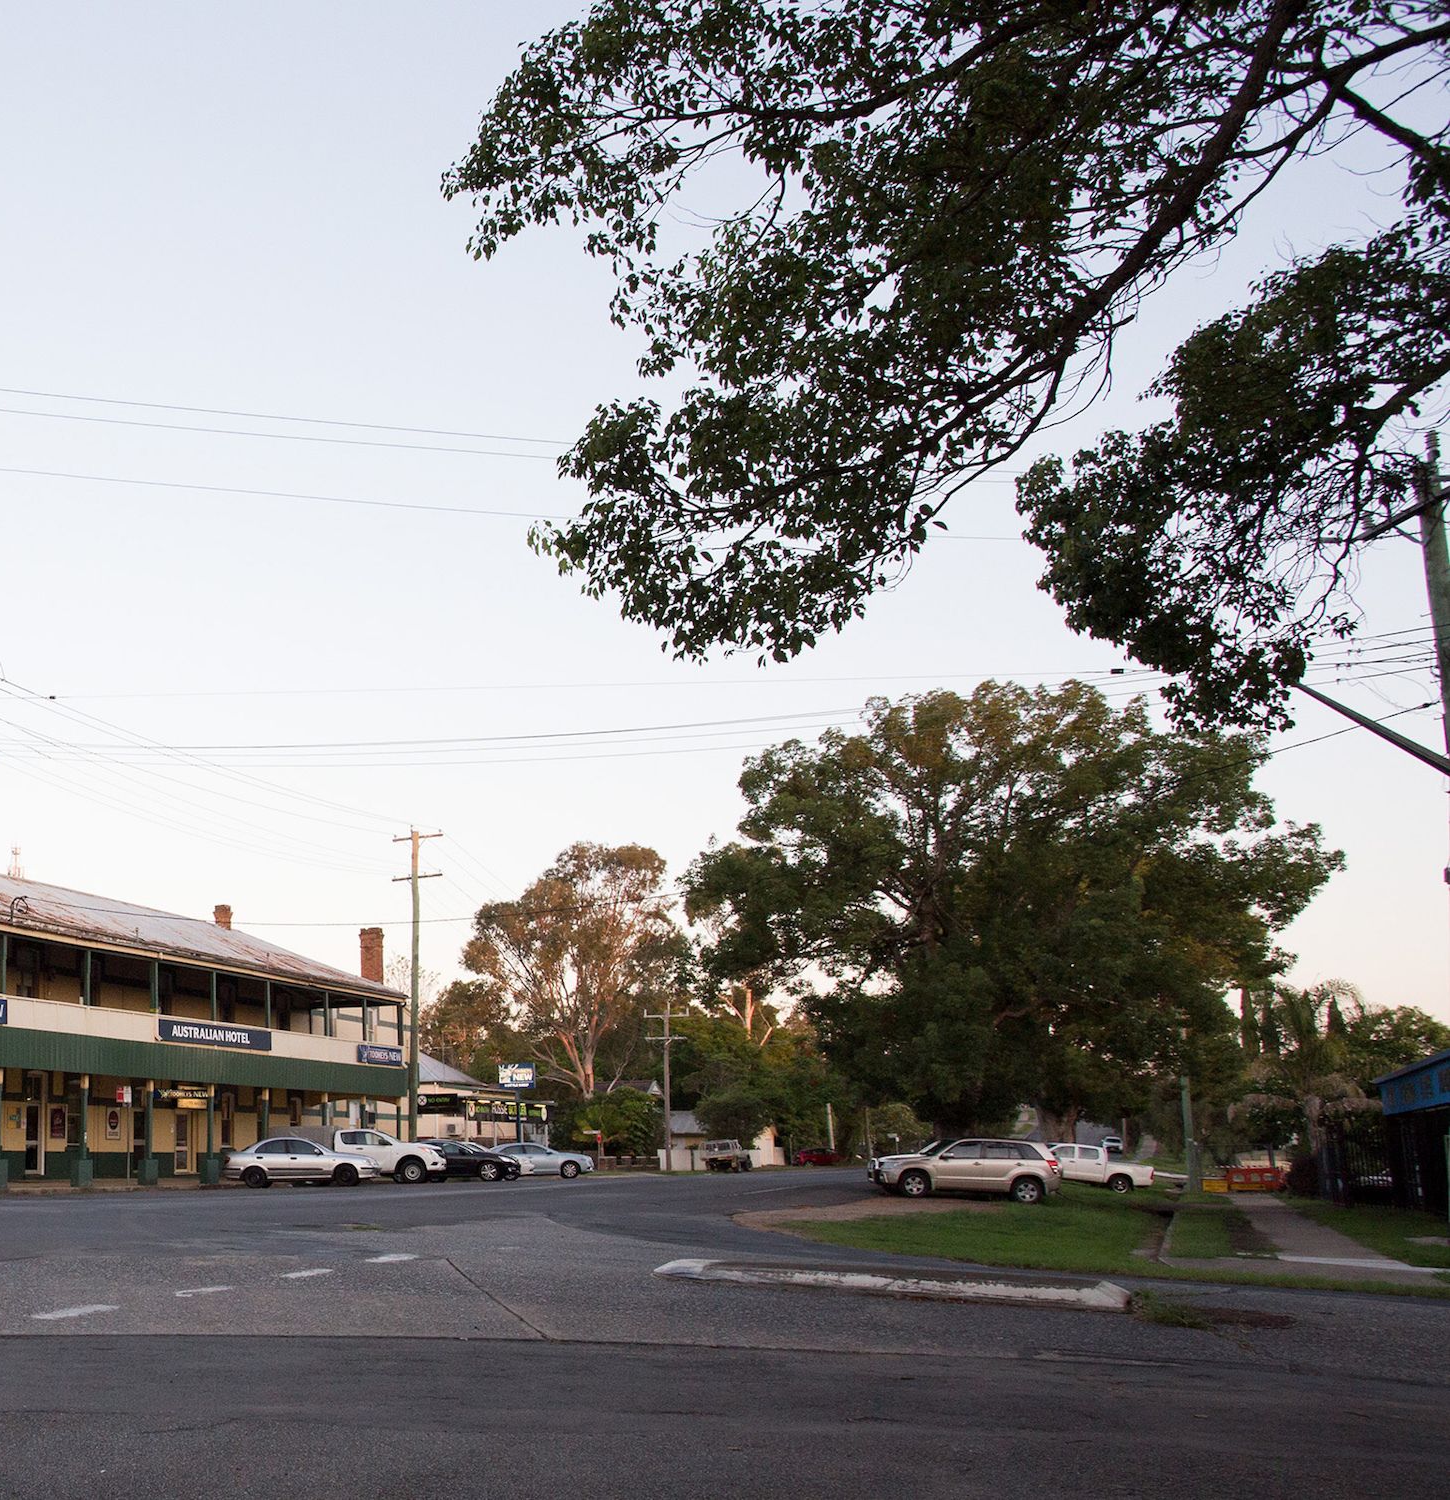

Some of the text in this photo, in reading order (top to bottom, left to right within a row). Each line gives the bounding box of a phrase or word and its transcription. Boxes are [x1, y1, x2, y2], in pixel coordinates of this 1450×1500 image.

[171, 1025, 251, 1044] AUSTRALIAN HOTEL
[389, 1051, 402, 1062] NEW
[512, 1072, 533, 1081] NEW
